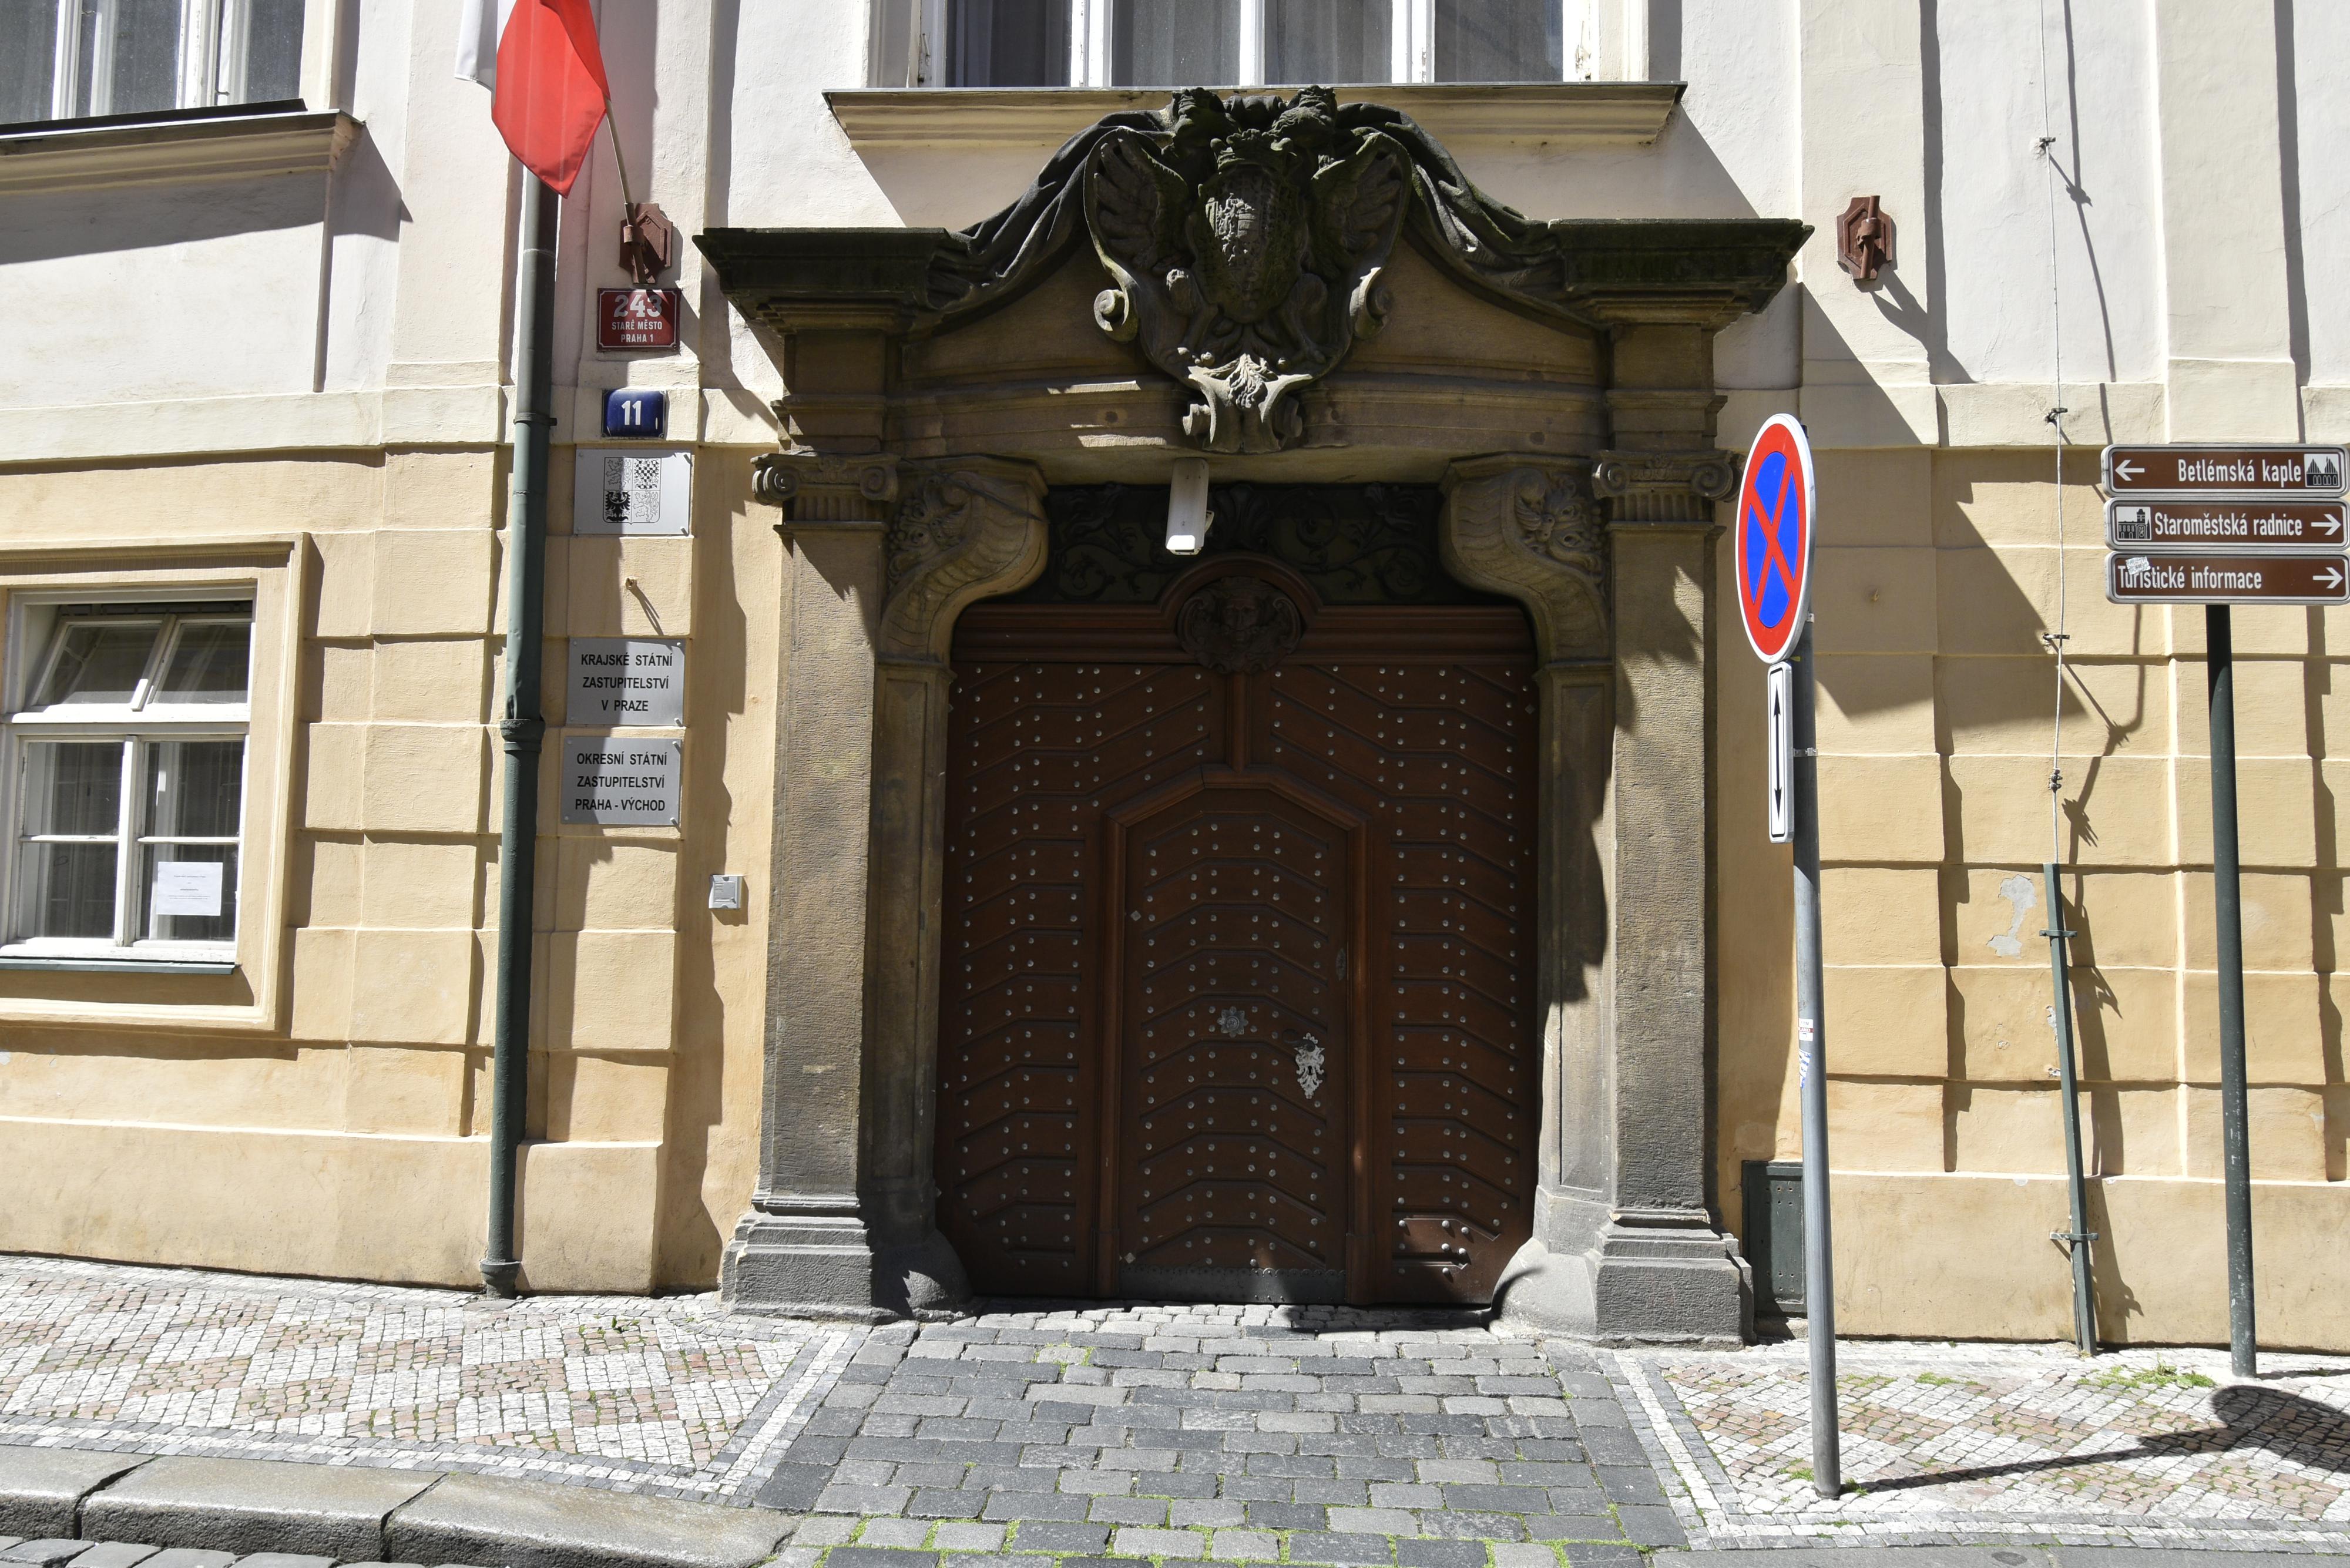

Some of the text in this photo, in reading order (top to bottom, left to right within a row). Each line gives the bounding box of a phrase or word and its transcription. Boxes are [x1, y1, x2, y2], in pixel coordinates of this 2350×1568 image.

[613, 294, 662, 317] 243
[612, 319, 663, 330] STARÉ MĚSTO
[620, 334, 653, 343] PRAHA 1
[621, 400, 642, 425] 11
[2178, 459, 2301, 488] Betlémská kaple
[2154, 512, 2302, 536] Staroměstská radnice
[2117, 566, 2262, 589] Turistické informace
[581, 652, 673, 667] KRAJSKÉ STÁTNÍ
[582, 676, 669, 689] ZASTUPITELSTVÍ
[602, 700, 649, 711] V PRAZE
[577, 751, 667, 765] OKRESNÍ STÁTNÍ
[577, 774, 665, 788] ZASTUPITELSTVÍ
[575, 798, 612, 810] PRAHA
[621, 797, 666, 811] VÝCHOD
